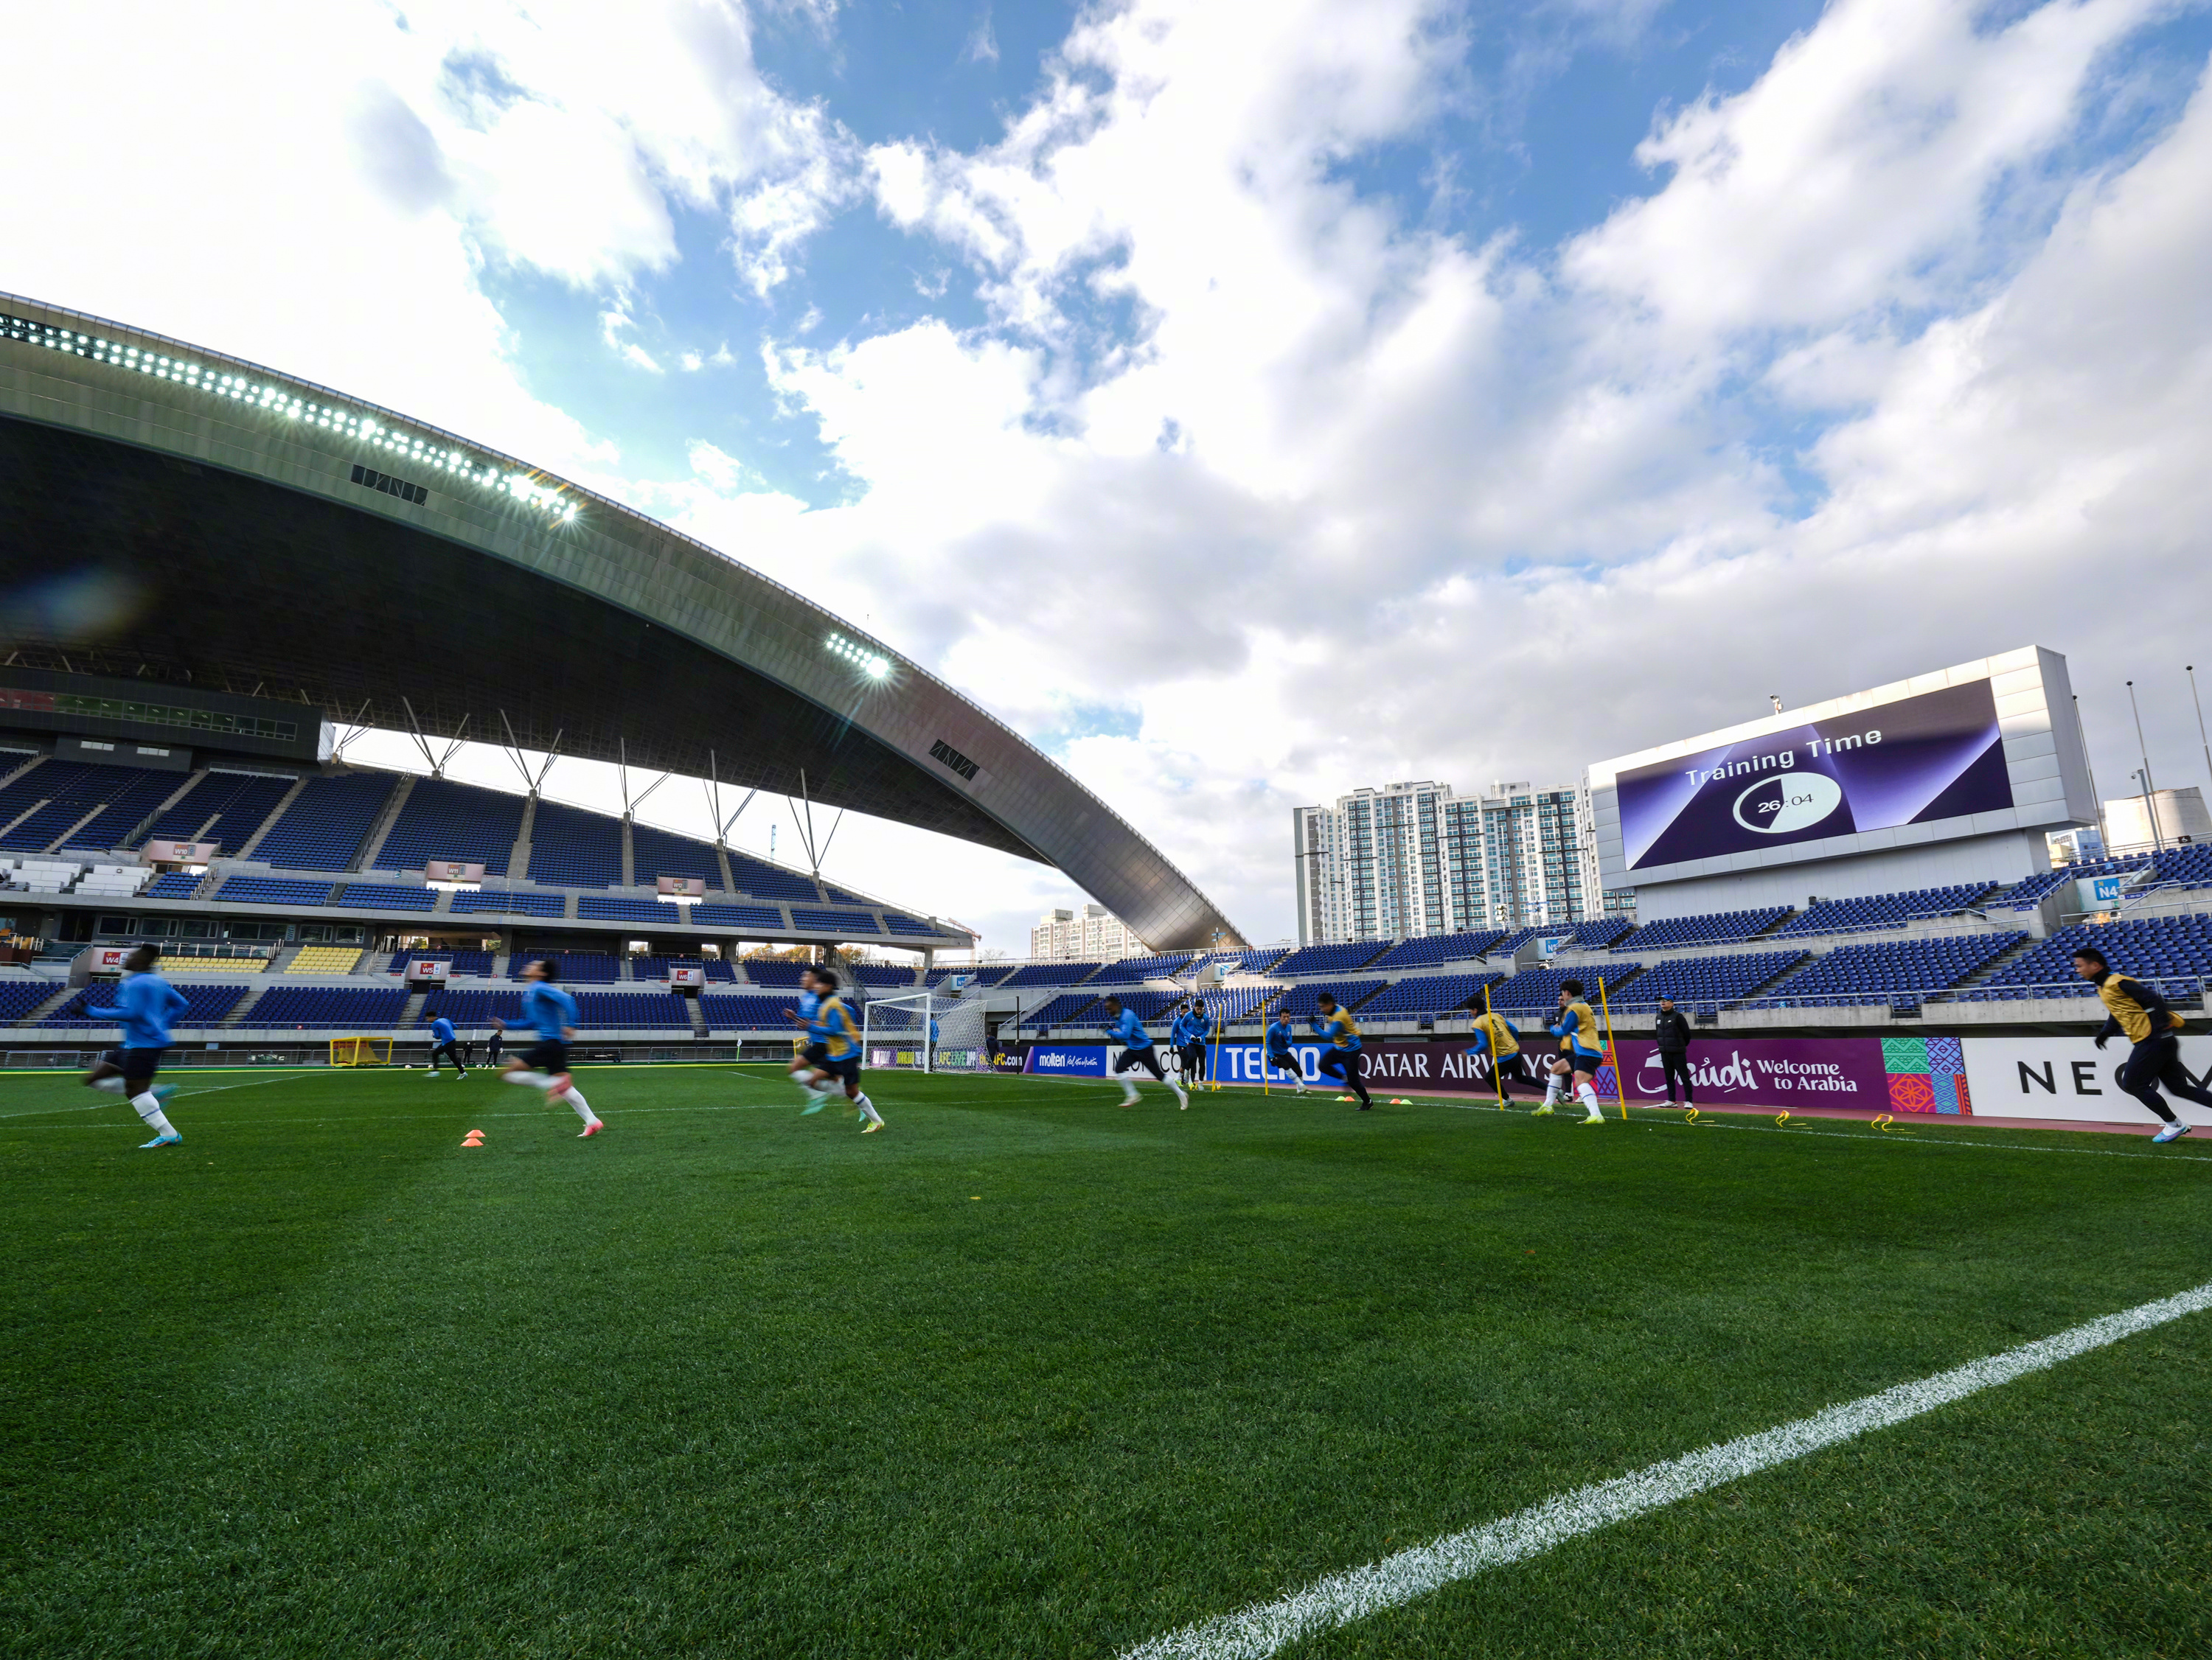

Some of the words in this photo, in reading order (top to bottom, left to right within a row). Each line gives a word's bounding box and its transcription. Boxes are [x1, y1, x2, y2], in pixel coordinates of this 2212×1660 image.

[1685, 750, 1795, 786] Training
[1806, 729, 1882, 758] Time
[1757, 793, 1815, 814] 26:04
[2098, 886, 2118, 899] N4
[1039, 1053, 1065, 1067] molten
[1358, 1053, 1430, 1078] QATAR
[1441, 1053, 1557, 1081] AIRYS
[1756, 1059, 1840, 1075] Welcome
[1774, 1076, 1792, 1089] to
[1797, 1075, 1857, 1092] Arabia
